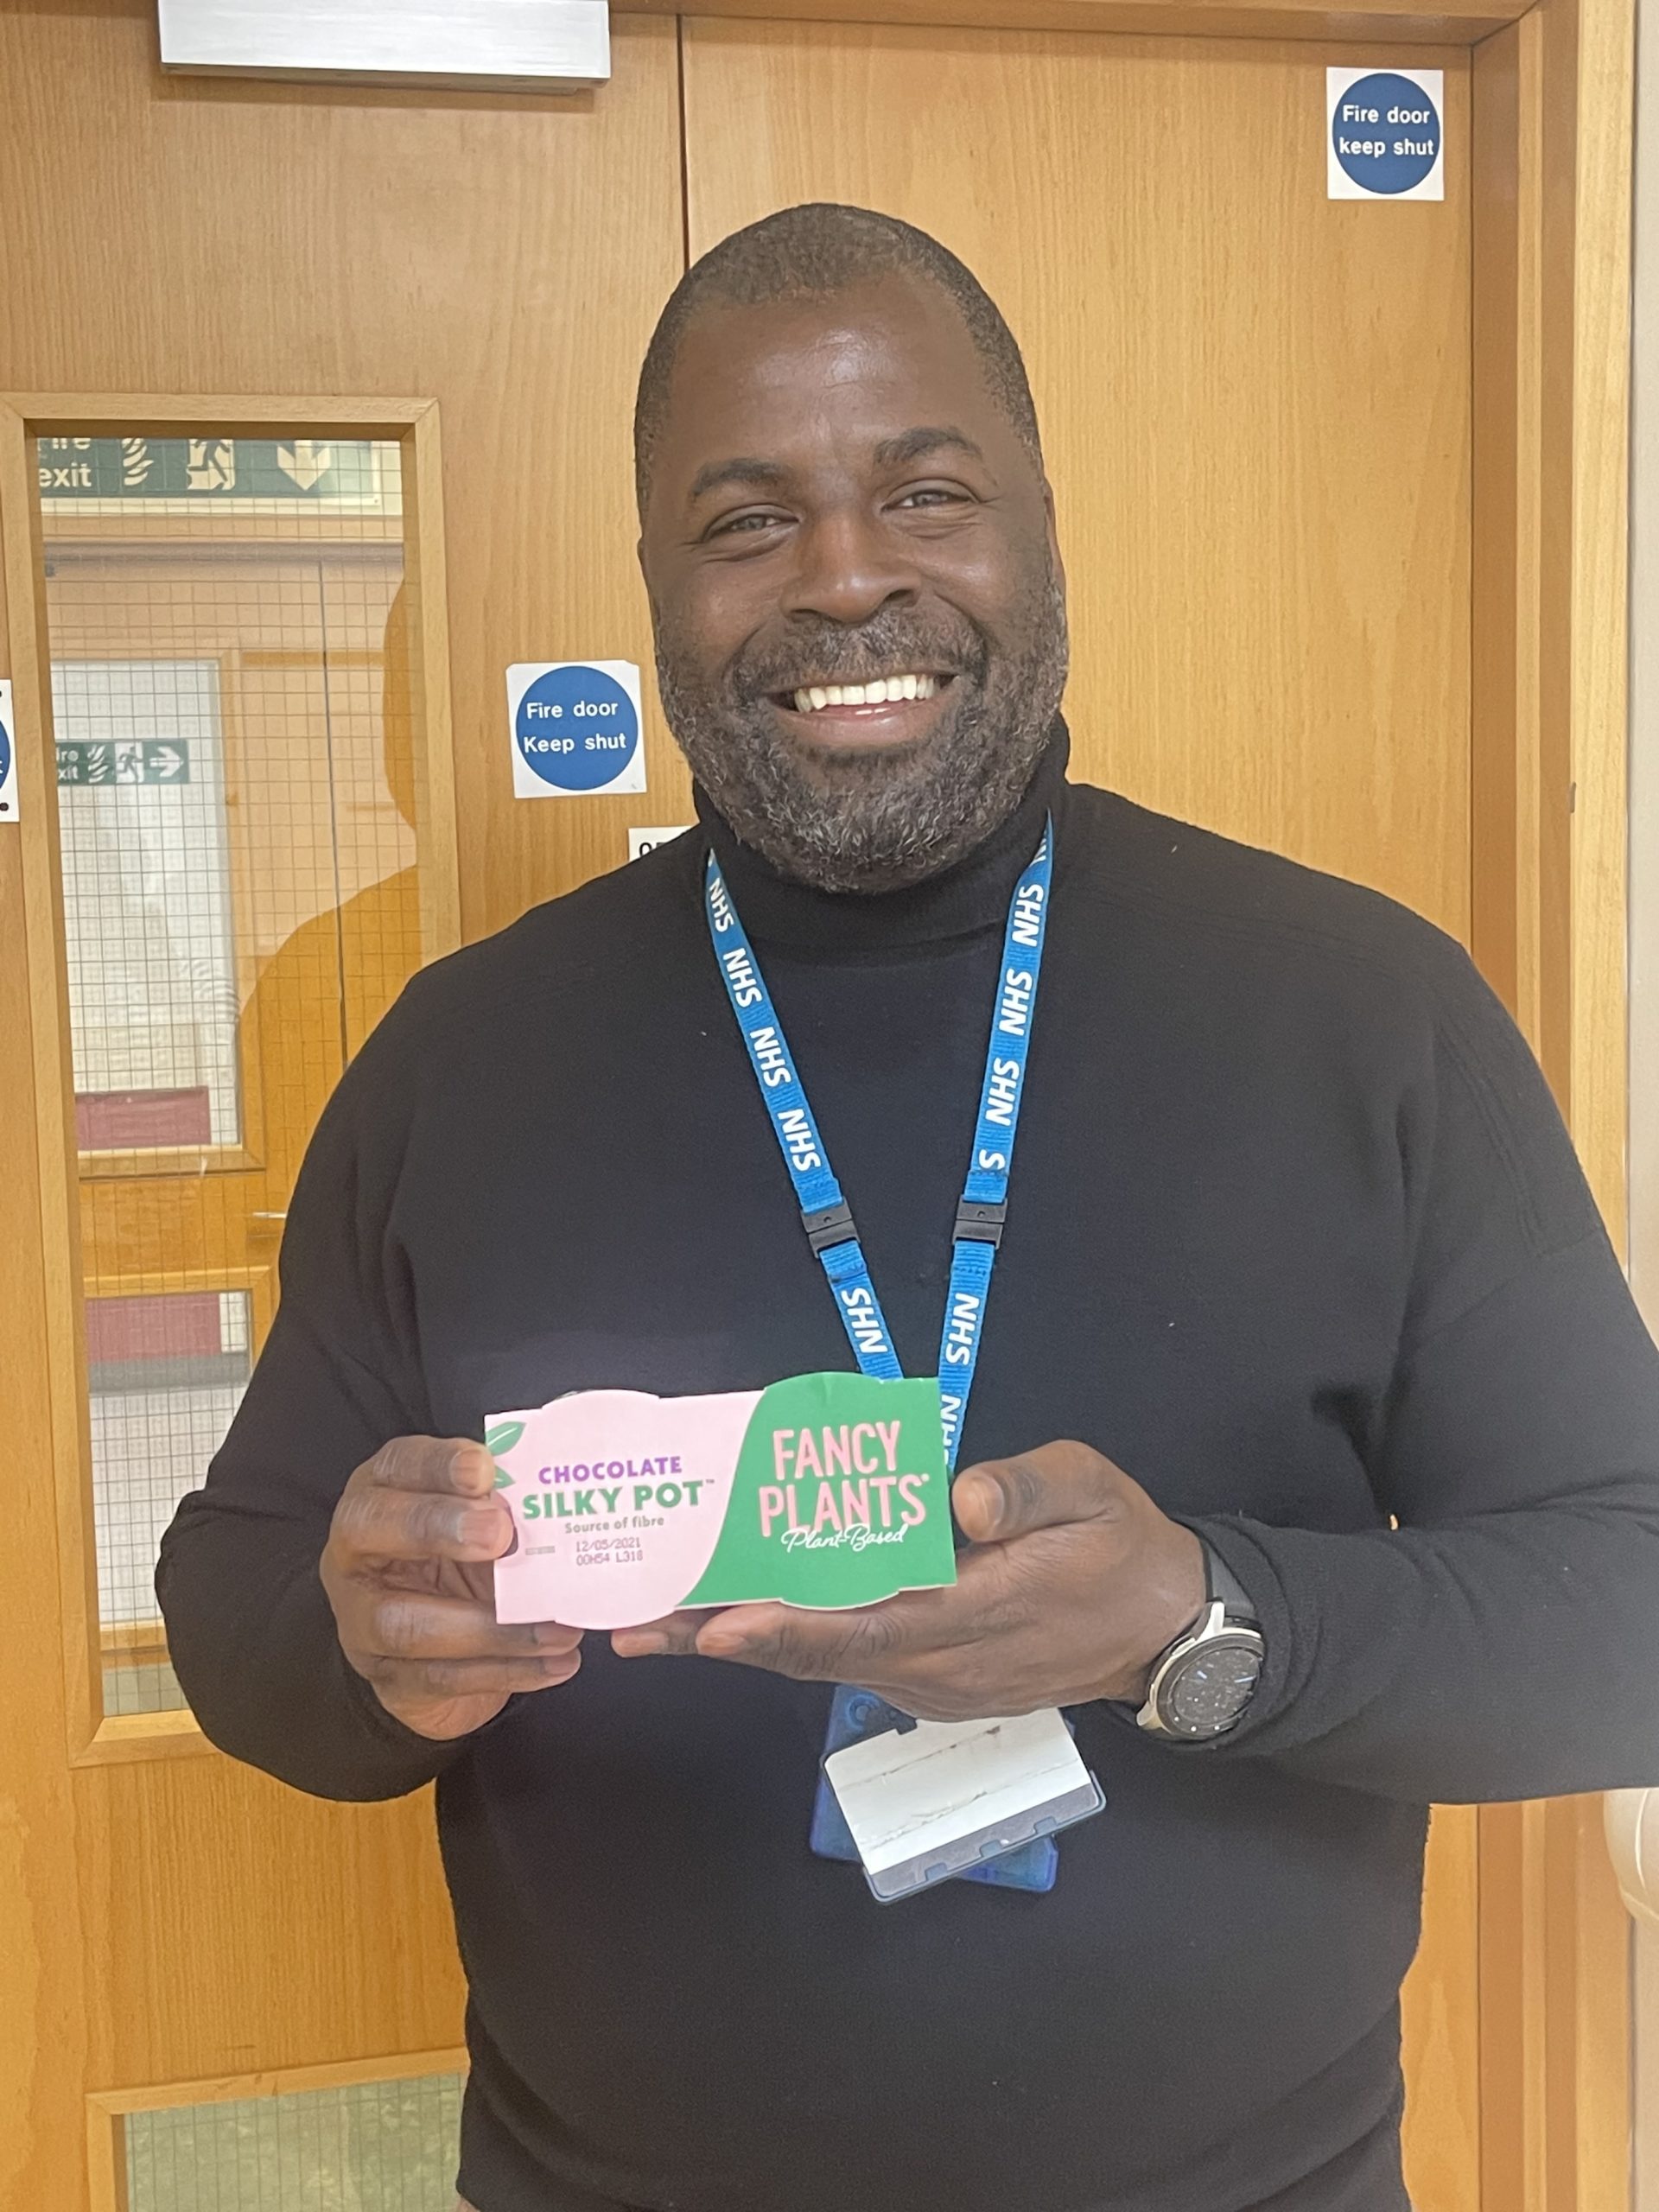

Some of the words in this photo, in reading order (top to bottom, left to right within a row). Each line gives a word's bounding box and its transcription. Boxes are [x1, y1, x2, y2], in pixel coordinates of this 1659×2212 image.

[1343, 105, 1379, 123] Fire
[1387, 106, 1430, 124] door
[1339, 137, 1386, 158] keep
[1393, 138, 1434, 156] shut
[39, 461, 92, 487] exit
[526, 702, 563, 719] Fire
[573, 701, 619, 717] door
[524, 737, 575, 754] Keep
[584, 733, 627, 751] shut
[58, 765, 79, 779] xit
[709, 877, 734, 932] NHS
[1012, 884, 1044, 947] NHS
[722, 947, 763, 1007] NHS
[998, 968, 1033, 1036] NHS
[749, 1026, 791, 1087] NHS
[985, 1057, 1020, 1127] NHS
[777, 1109, 822, 1171] NHS
[841, 1288, 888, 1354] NHS
[945, 1294, 980, 1366] NHS
[538, 1456, 683, 1484] CHOCOLATE
[773, 1420, 900, 1480] FANCY
[522, 1486, 623, 1520] SILKY
[564, 1522, 610, 1534] Source
[613, 1516, 628, 1529] of
[632, 1516, 664, 1529] fibre
[759, 1474, 926, 1537] PLANTS
[780, 1522, 908, 1553] Plant-Based
